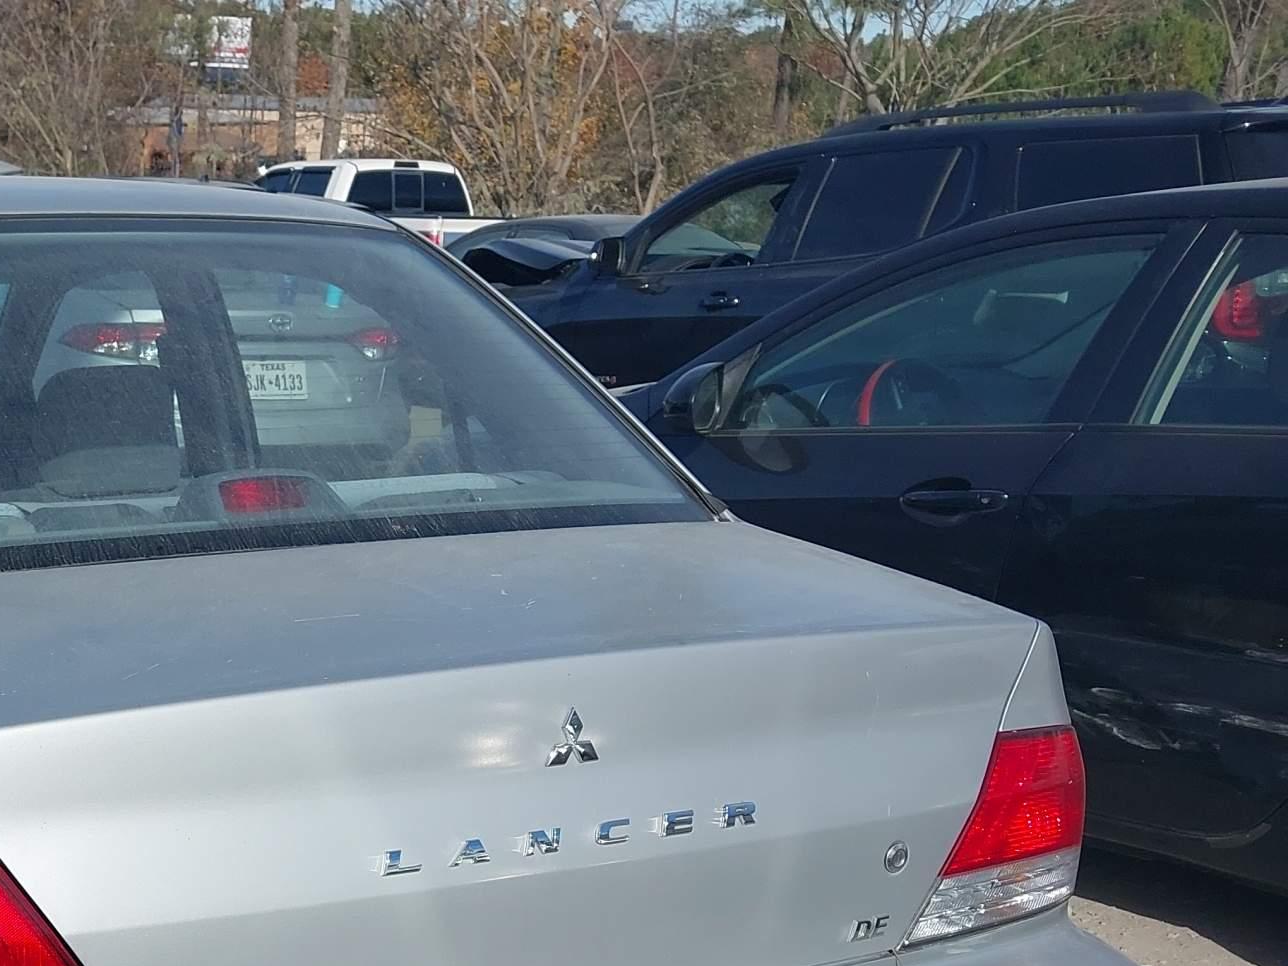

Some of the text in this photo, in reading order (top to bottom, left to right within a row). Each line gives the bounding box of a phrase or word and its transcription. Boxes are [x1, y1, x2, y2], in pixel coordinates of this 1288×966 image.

[261, 362, 286, 371] TEXAS
[376, 800, 758, 878] LANCER
[847, 914, 890, 943] DE
